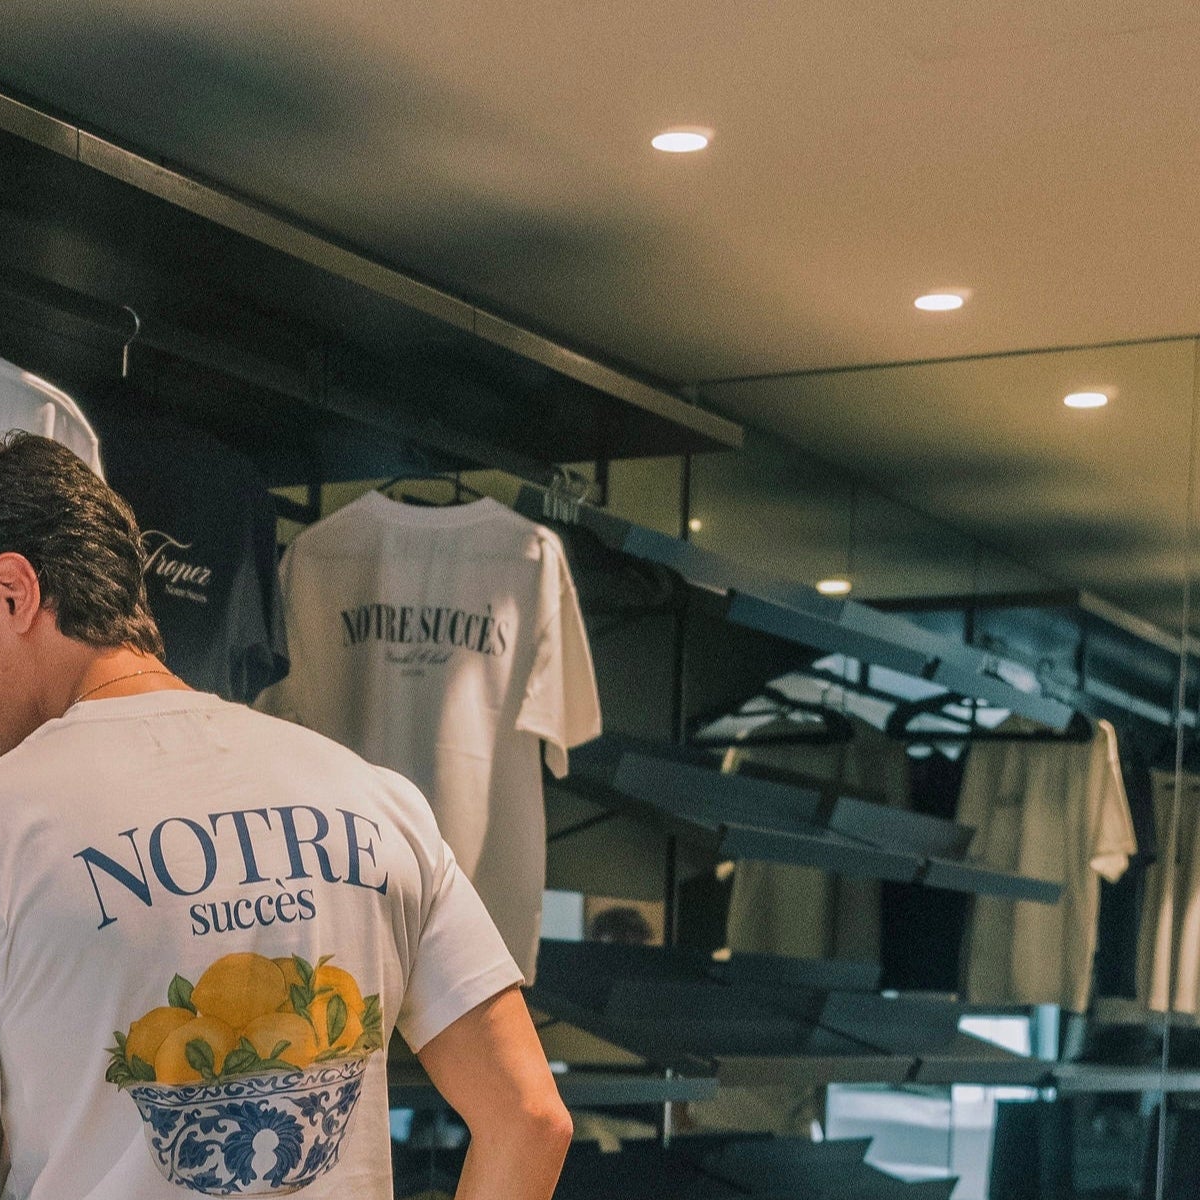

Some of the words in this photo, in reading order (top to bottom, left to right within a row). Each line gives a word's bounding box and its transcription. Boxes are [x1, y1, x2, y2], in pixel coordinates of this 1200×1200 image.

[341, 603, 414, 647] NOTRE
[418, 603, 509, 656] SUCCÈS
[73, 805, 389, 930] NOTRE
[189, 879, 316, 936] succès
